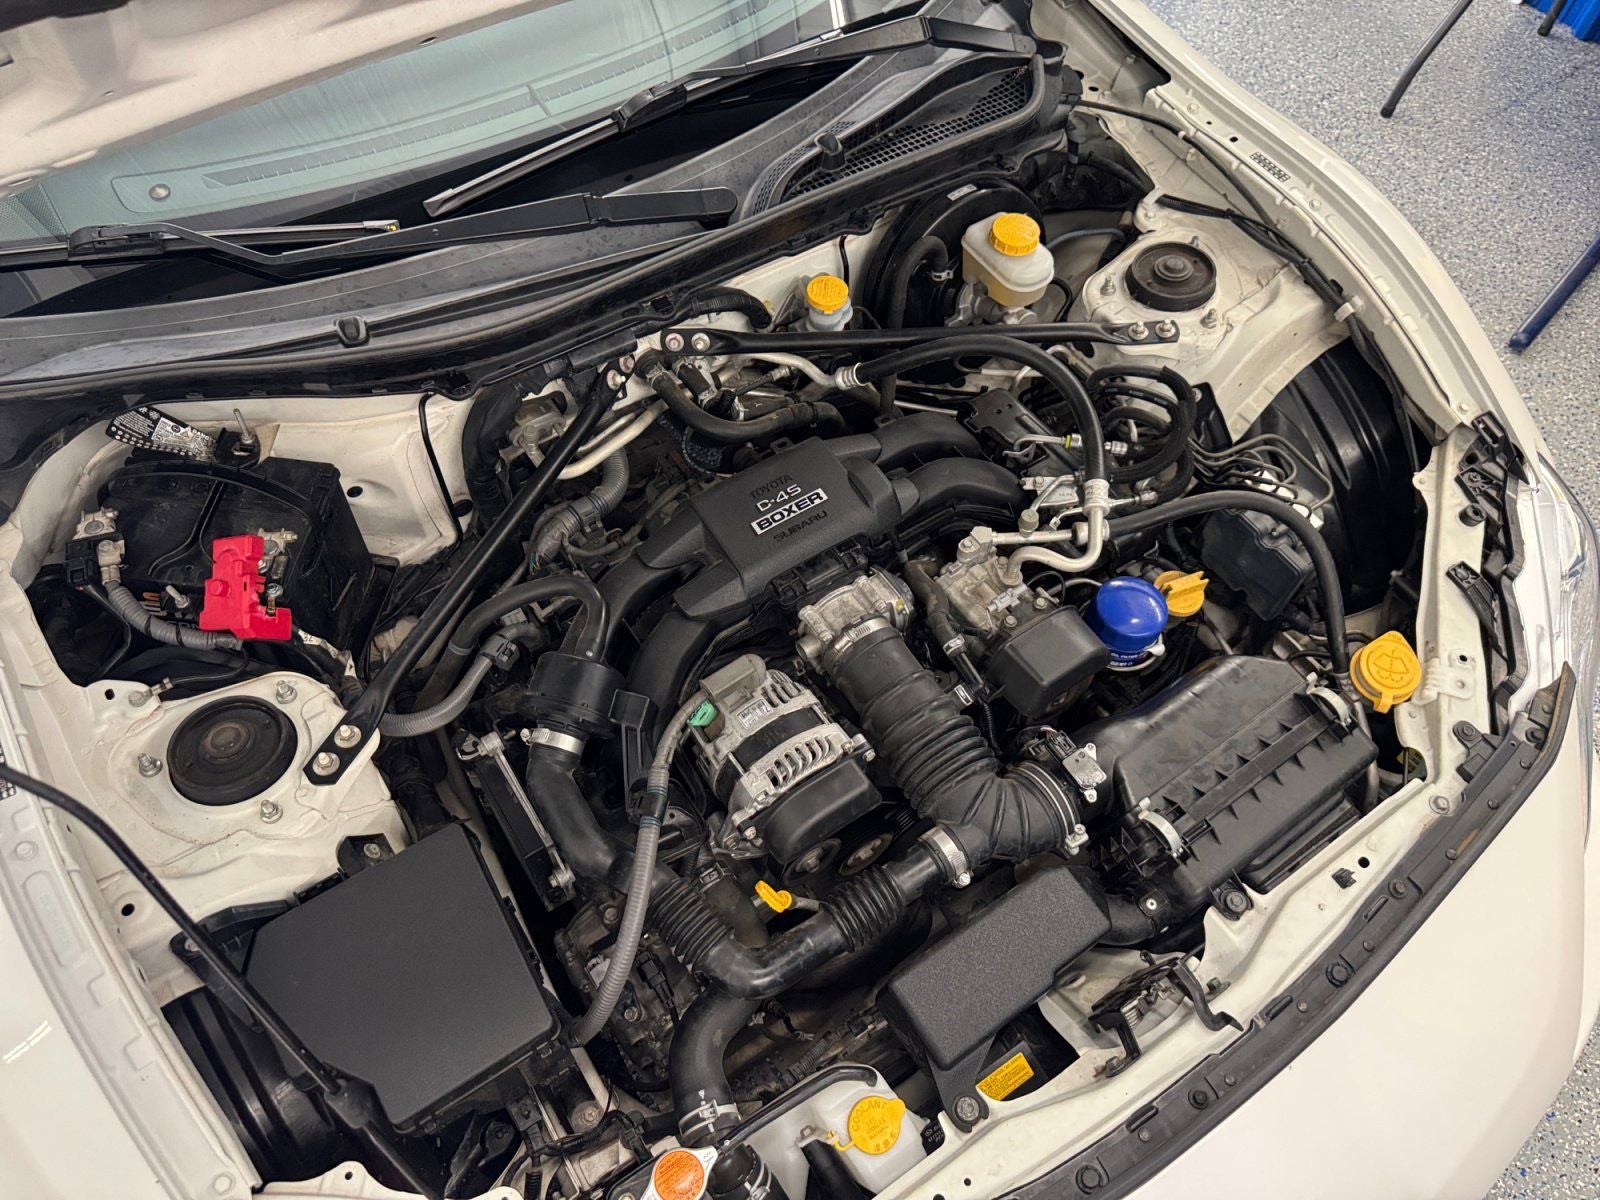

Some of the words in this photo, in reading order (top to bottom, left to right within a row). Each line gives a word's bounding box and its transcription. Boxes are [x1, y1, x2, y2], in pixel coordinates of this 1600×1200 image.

[750, 474, 793, 499] TOYOTA
[756, 483, 802, 512] D-4S
[755, 491, 824, 531] BOXER
[773, 510, 828, 541] SUBARU
[852, 1099, 887, 1132] COOLANT
